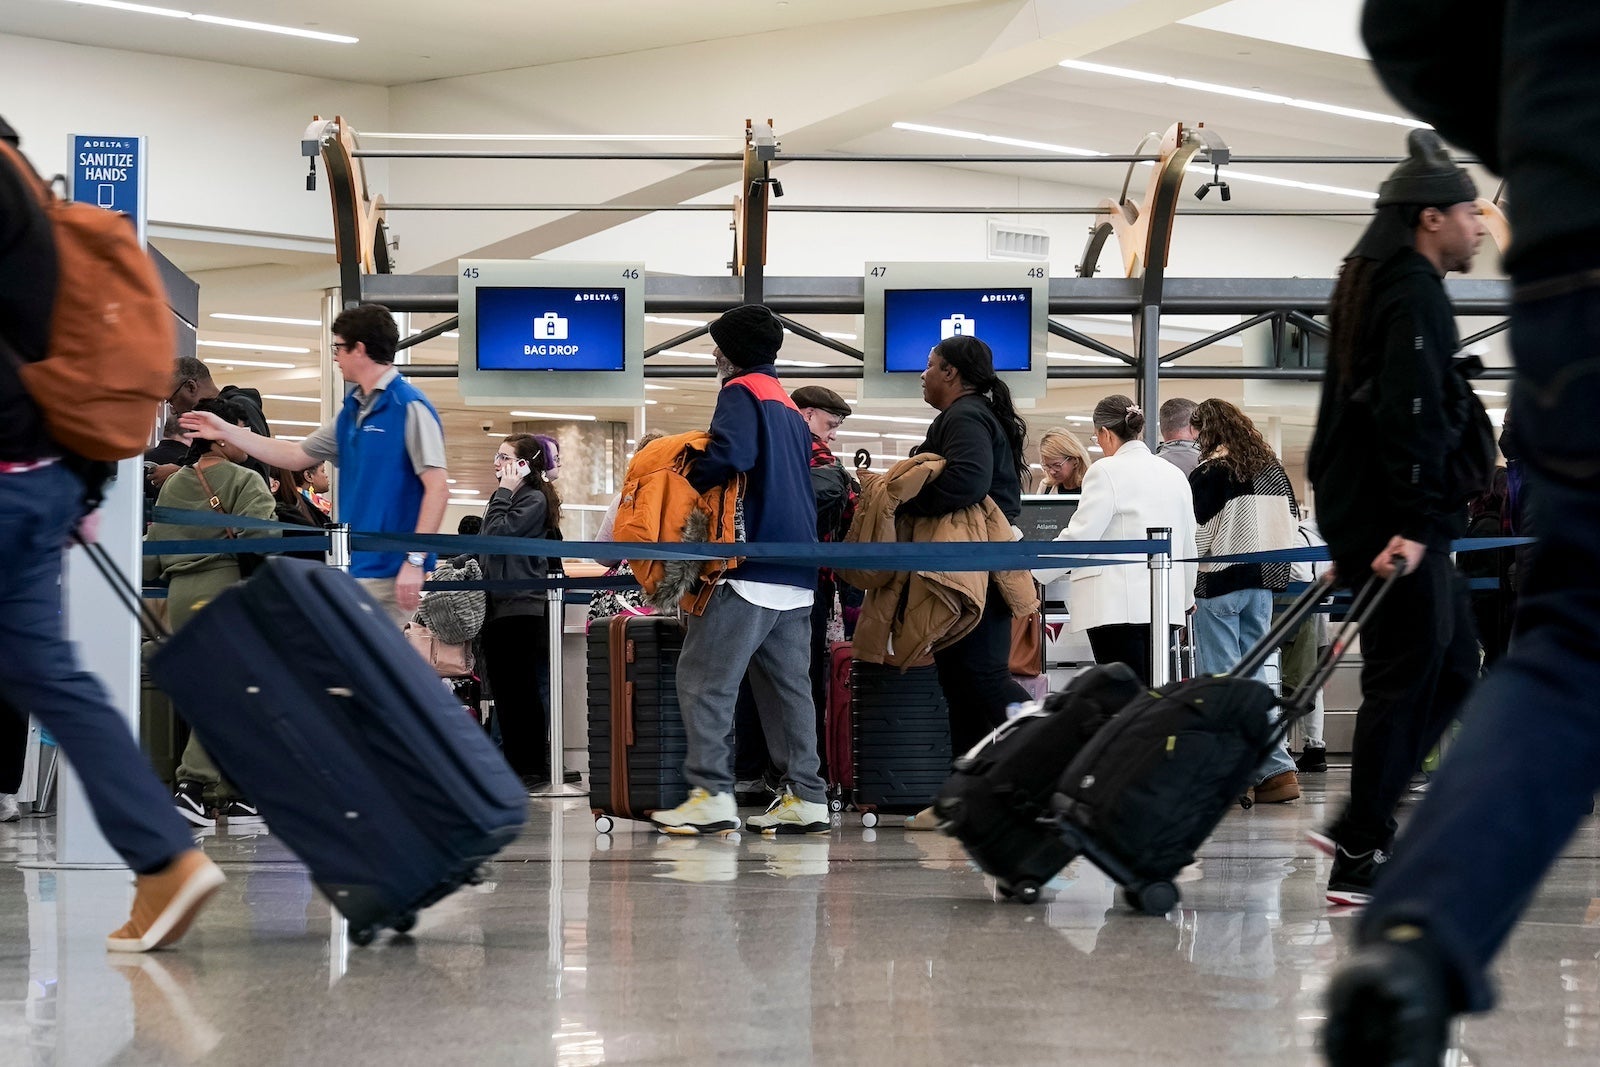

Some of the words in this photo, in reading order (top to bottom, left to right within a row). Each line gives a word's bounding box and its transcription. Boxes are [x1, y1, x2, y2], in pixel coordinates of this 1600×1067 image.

[79, 152, 134, 167] SANITIZE
[85, 167, 128, 181] HANDS
[463, 267, 480, 279] 45
[622, 268, 639, 280] 46
[870, 266, 887, 278] 47
[1027, 267, 1044, 279] 48
[583, 293, 611, 301] DELTA
[989, 294, 1018, 302] DELTA
[523, 345, 547, 356] BAG
[549, 345, 579, 356] DROP
[858, 452, 868, 468] 2
